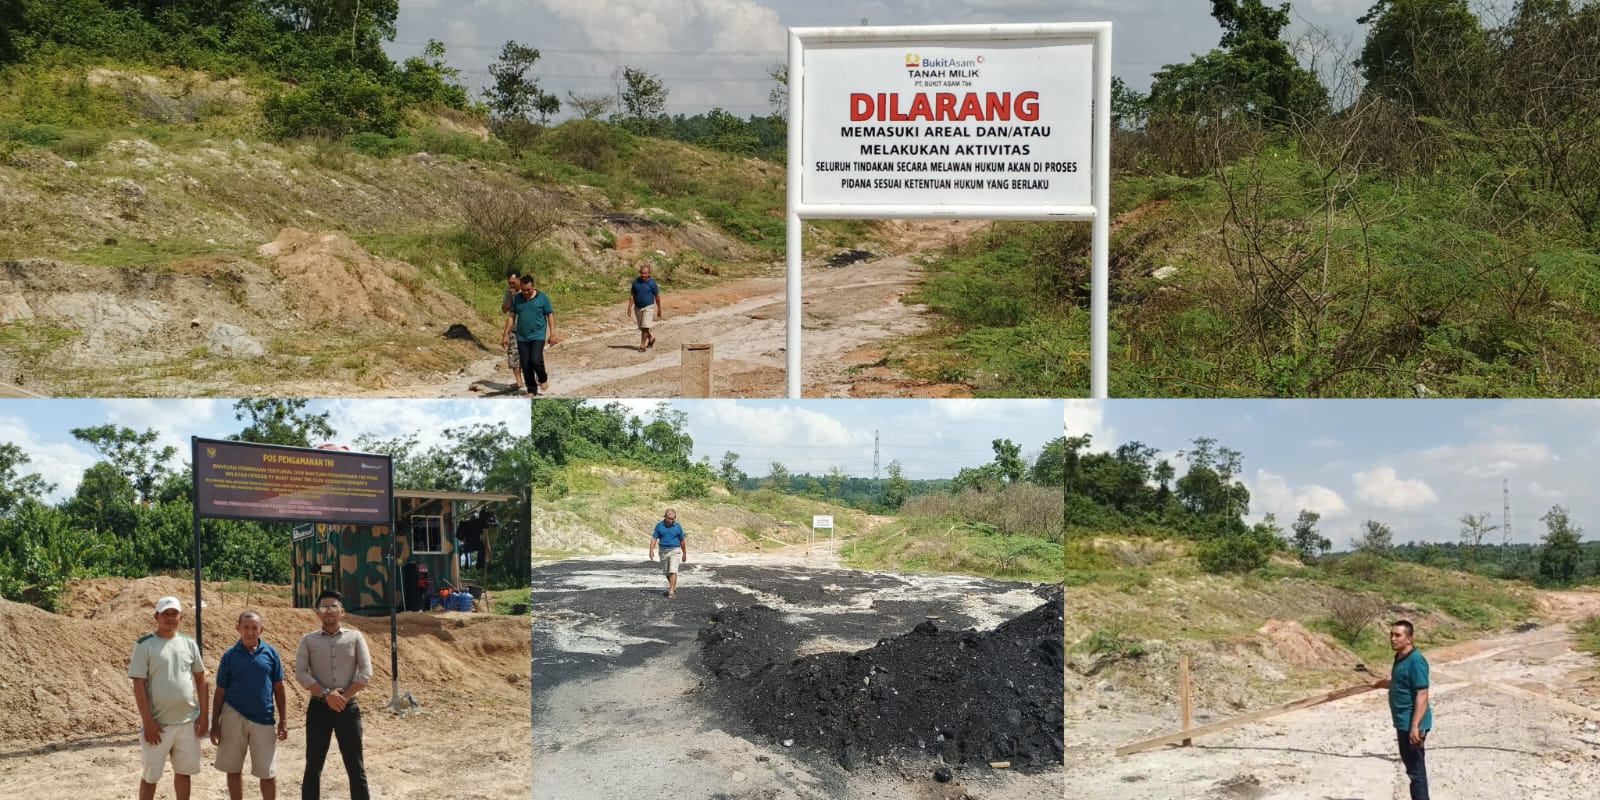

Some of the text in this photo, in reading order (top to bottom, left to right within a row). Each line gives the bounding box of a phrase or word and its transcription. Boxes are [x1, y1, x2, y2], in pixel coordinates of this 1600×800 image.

[922, 58, 975, 68] BukitAsam
[908, 69, 980, 78] TANAH MILIK
[849, 91, 1040, 122] DILARANG
[841, 126, 1051, 138] MEMASUKI AREAL DAN/ATAU
[860, 144, 1031, 155] MELAKUKAN AKTIVITAS
[815, 161, 1078, 173] SELURUH TINDAKAN SECARA MELAWAN HUKUM AKAN DI PROSES
[841, 178, 1049, 190] PIDANA SESUAI KETENTUAN HUKUM YANG BERLAKU
[263, 454, 335, 468] POS PENGAMANAN TNI
